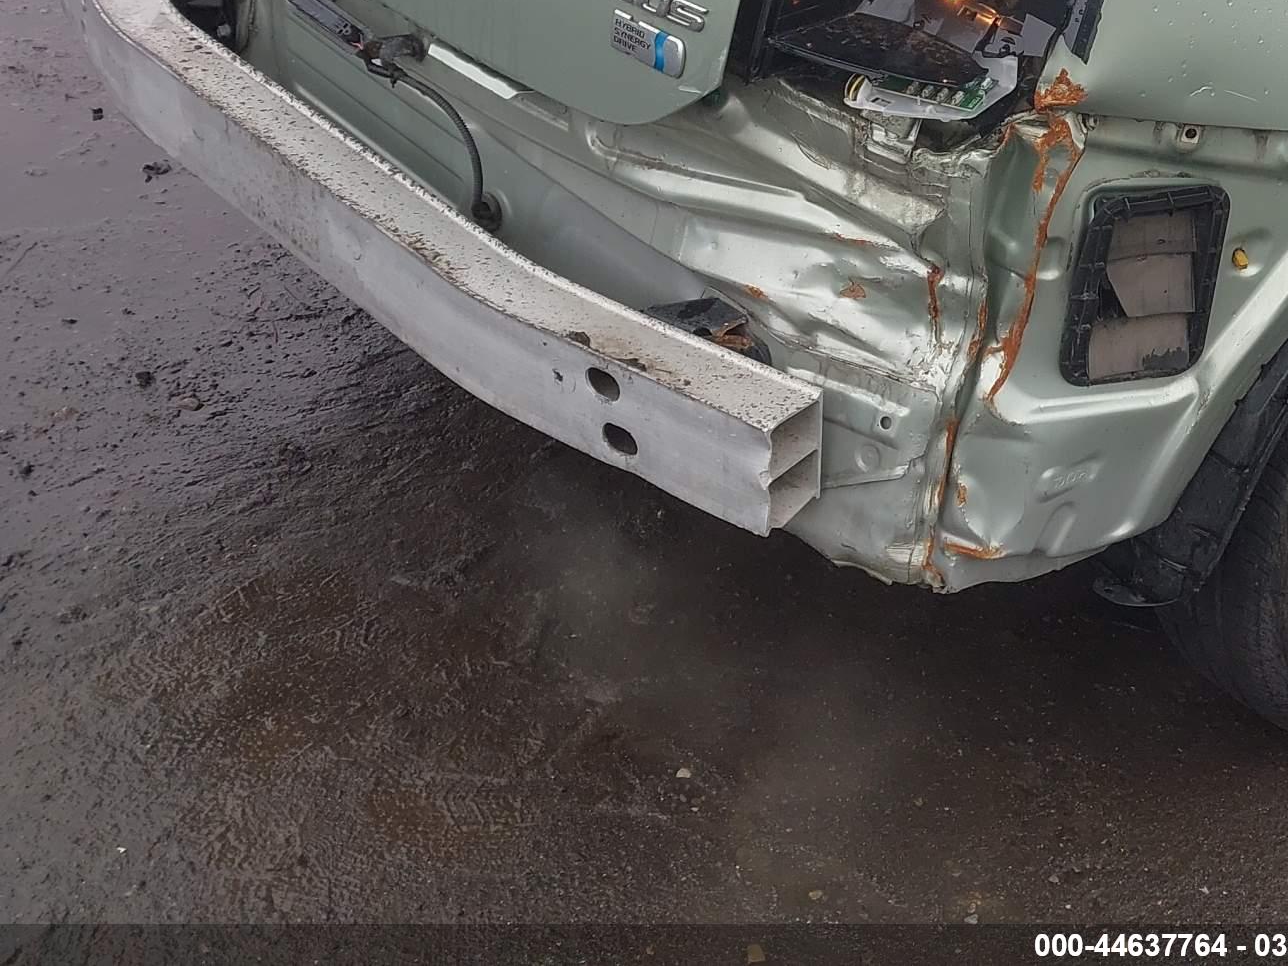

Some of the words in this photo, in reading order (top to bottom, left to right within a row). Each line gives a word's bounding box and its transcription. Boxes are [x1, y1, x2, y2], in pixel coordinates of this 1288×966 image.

[614, 27, 651, 49] SYNERGY
[615, 18, 645, 38] HYBRID
[613, 35, 636, 51] DRIVE
